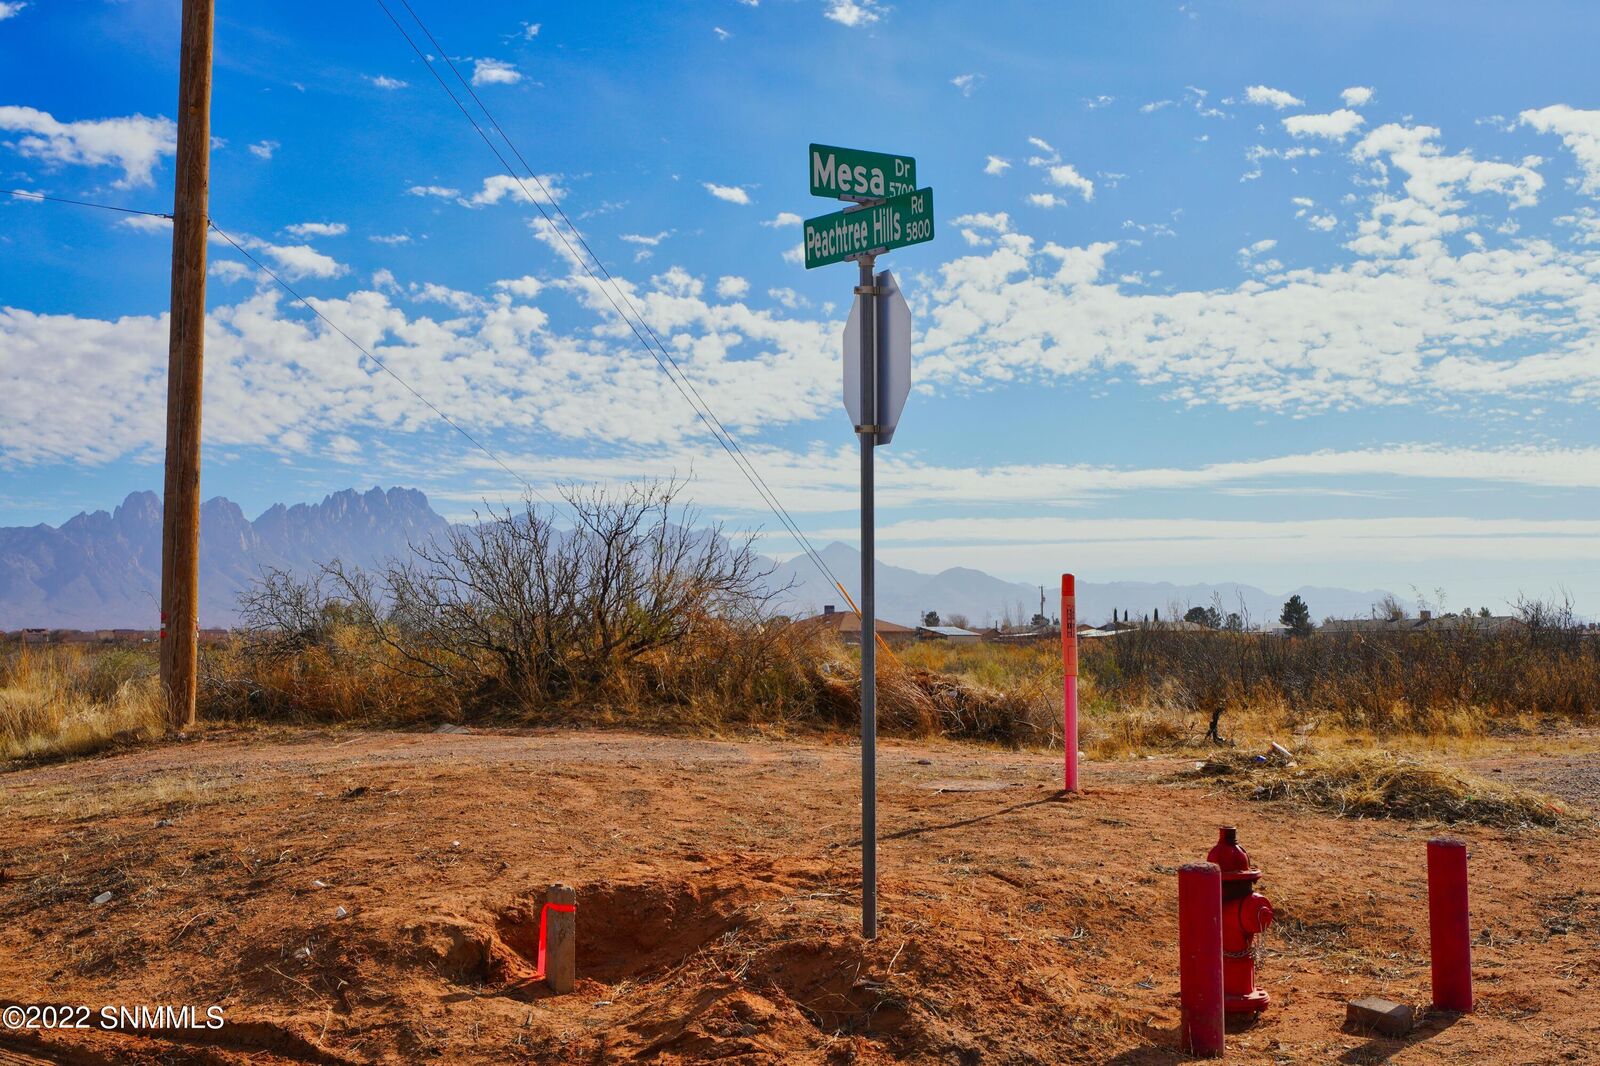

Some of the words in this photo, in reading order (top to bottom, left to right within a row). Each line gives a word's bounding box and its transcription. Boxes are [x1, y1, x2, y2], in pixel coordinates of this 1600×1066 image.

[813, 151, 885, 196] Mesa
[895, 158, 911, 178] Dr
[806, 218, 868, 261] Peachtree
[873, 206, 902, 245] Hills
[911, 194, 924, 215] Rd
[906, 218, 931, 242] 5800
